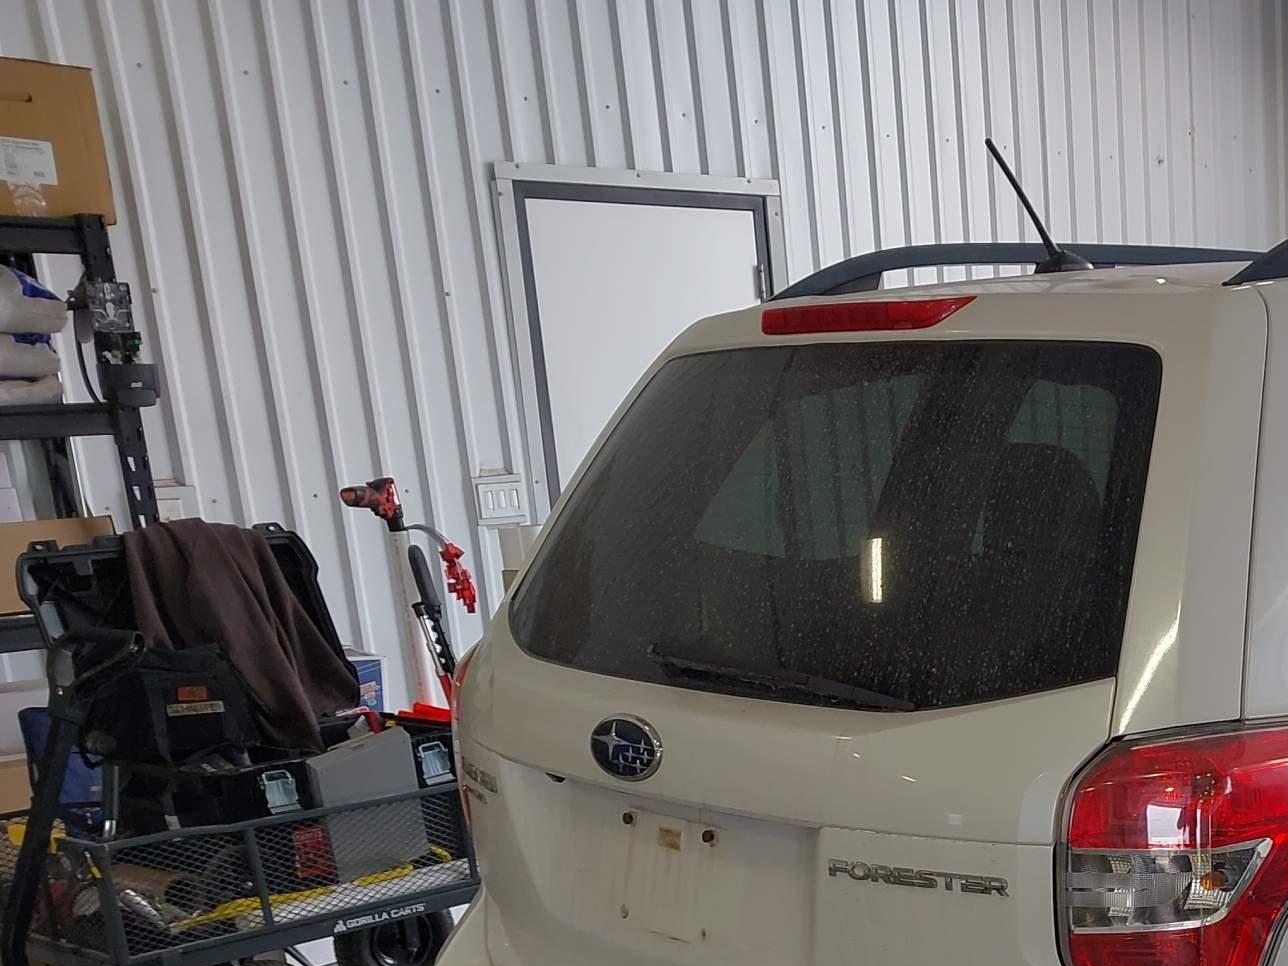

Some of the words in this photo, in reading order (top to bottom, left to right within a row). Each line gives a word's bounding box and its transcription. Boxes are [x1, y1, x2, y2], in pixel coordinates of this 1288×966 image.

[828, 858, 1010, 897] FORESTER
[346, 913, 390, 929] GORILLA
[390, 904, 425, 919] CARTS
